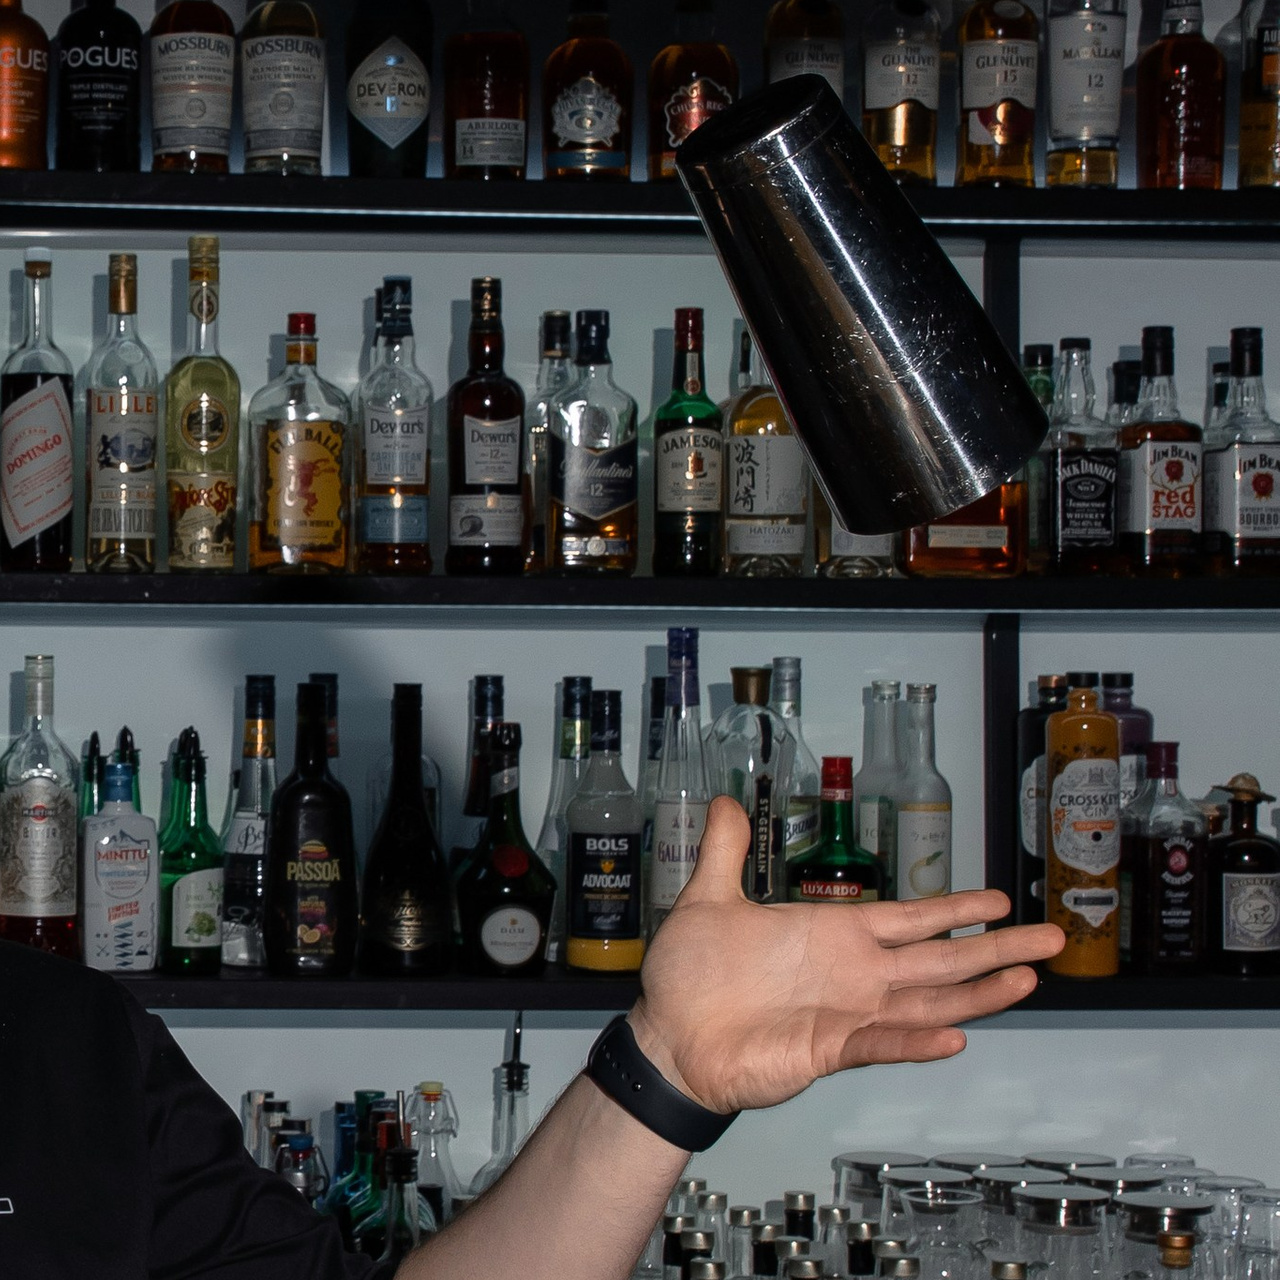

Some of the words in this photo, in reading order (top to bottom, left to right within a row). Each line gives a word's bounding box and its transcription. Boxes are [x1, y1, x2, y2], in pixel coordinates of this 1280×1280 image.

[158, 38, 231, 58] MOSSBURN
[244, 37, 321, 61] MOSSBURN
[1001, 46, 1019, 54] THE
[59, 45, 139, 71] POGUES
[976, 55, 1035, 69] GLENLIVET
[1002, 70, 1018, 84] 15
[1087, 73, 1104, 88] 12
[357, 82, 426, 98] DEVERON
[471, 429, 517, 444] Dewar's
[6, 434, 62, 475] DOMINGO
[1150, 448, 1170, 466] JIM
[1171, 445, 1198, 466] BEAM
[590, 483, 603, 497] 12
[1153, 484, 1195, 505] red
[1152, 506, 1196, 519] STAG
[1059, 794, 1098, 807] CROSS
[758, 798, 769, 875] ST-GERMAIN
[586, 838, 629, 851] BOLS
[97, 849, 148, 861] MINTTU
[582, 874, 631, 888] ADVOCAAT
[802, 882, 859, 897] LUXARDO
